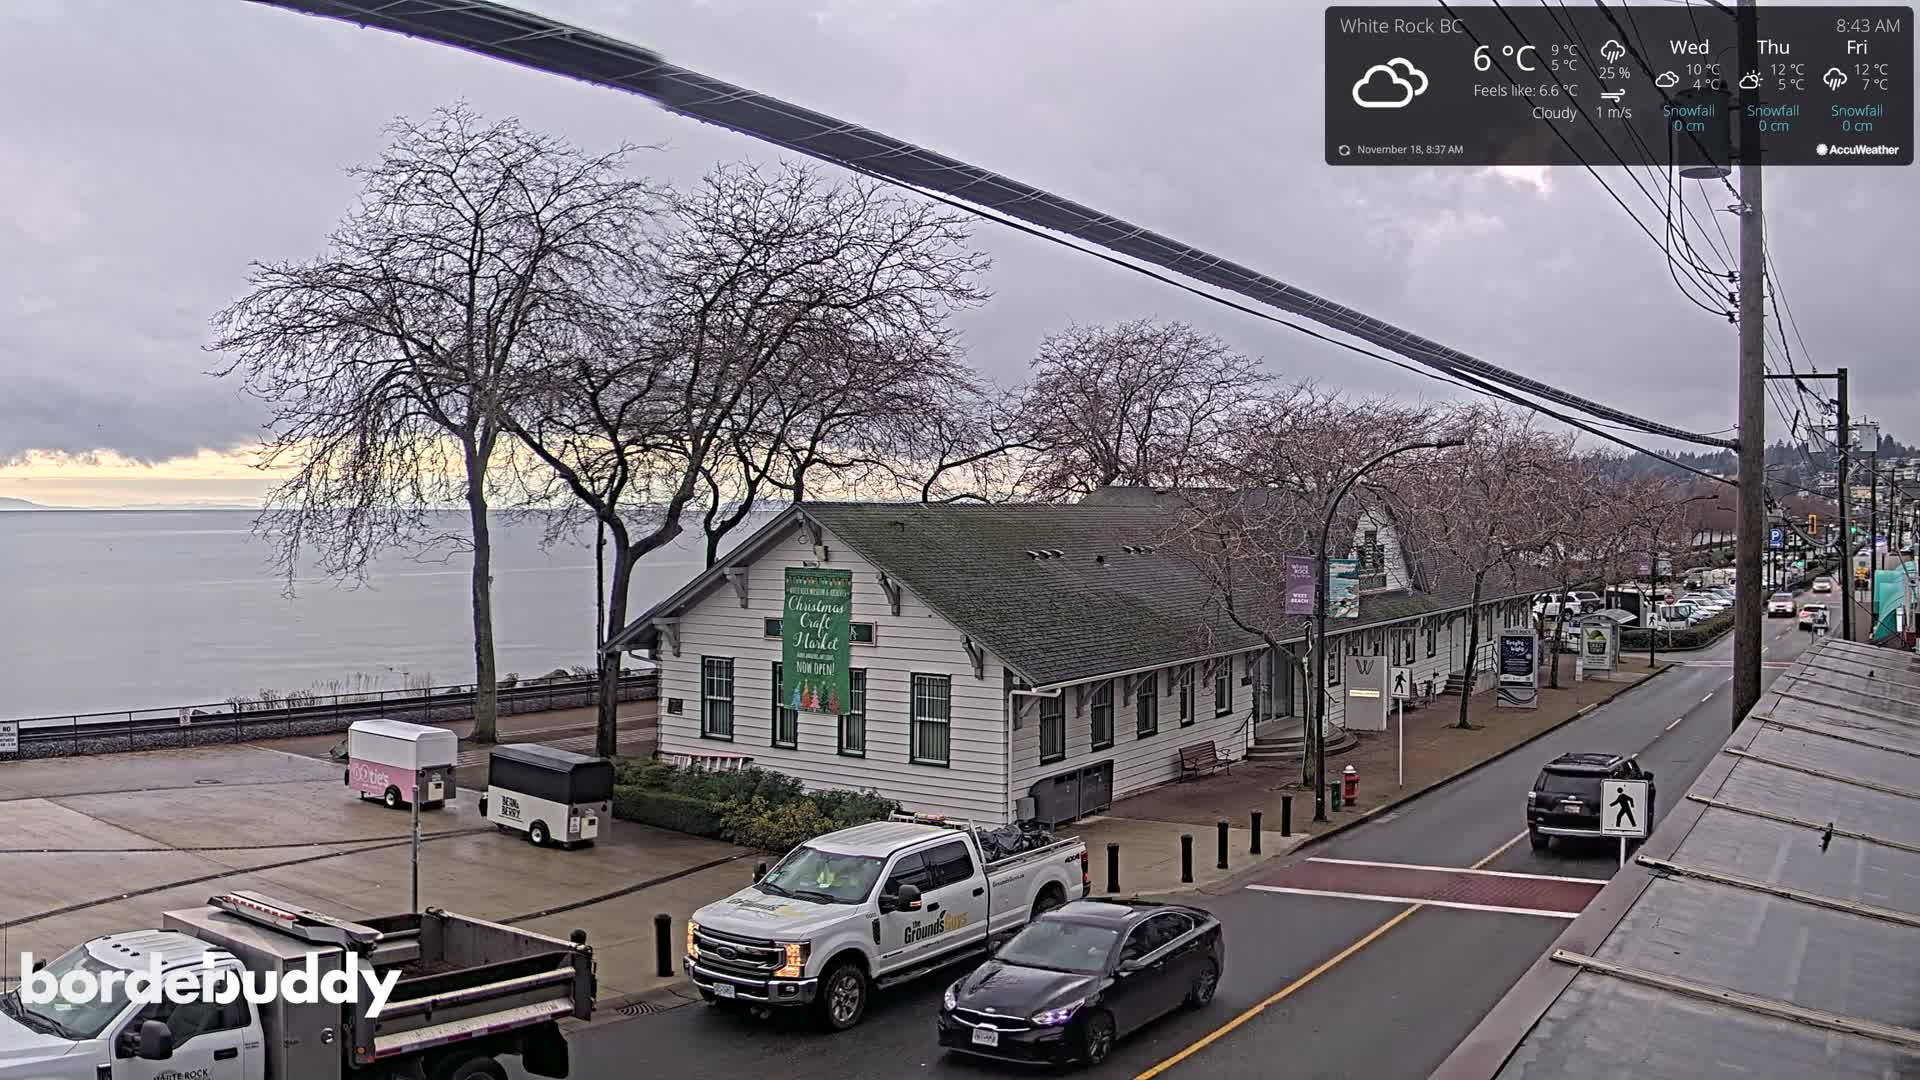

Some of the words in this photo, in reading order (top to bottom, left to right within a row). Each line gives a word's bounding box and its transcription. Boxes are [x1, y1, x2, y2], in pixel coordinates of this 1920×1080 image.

[788, 595, 845, 613] Christmas
[800, 612, 831, 638] Craft
[792, 631, 839, 651] Market
[796, 660, 812, 673] NOW
[904, 918, 945, 944] Grounds
[184, 1068, 208, 1080] ROCK
